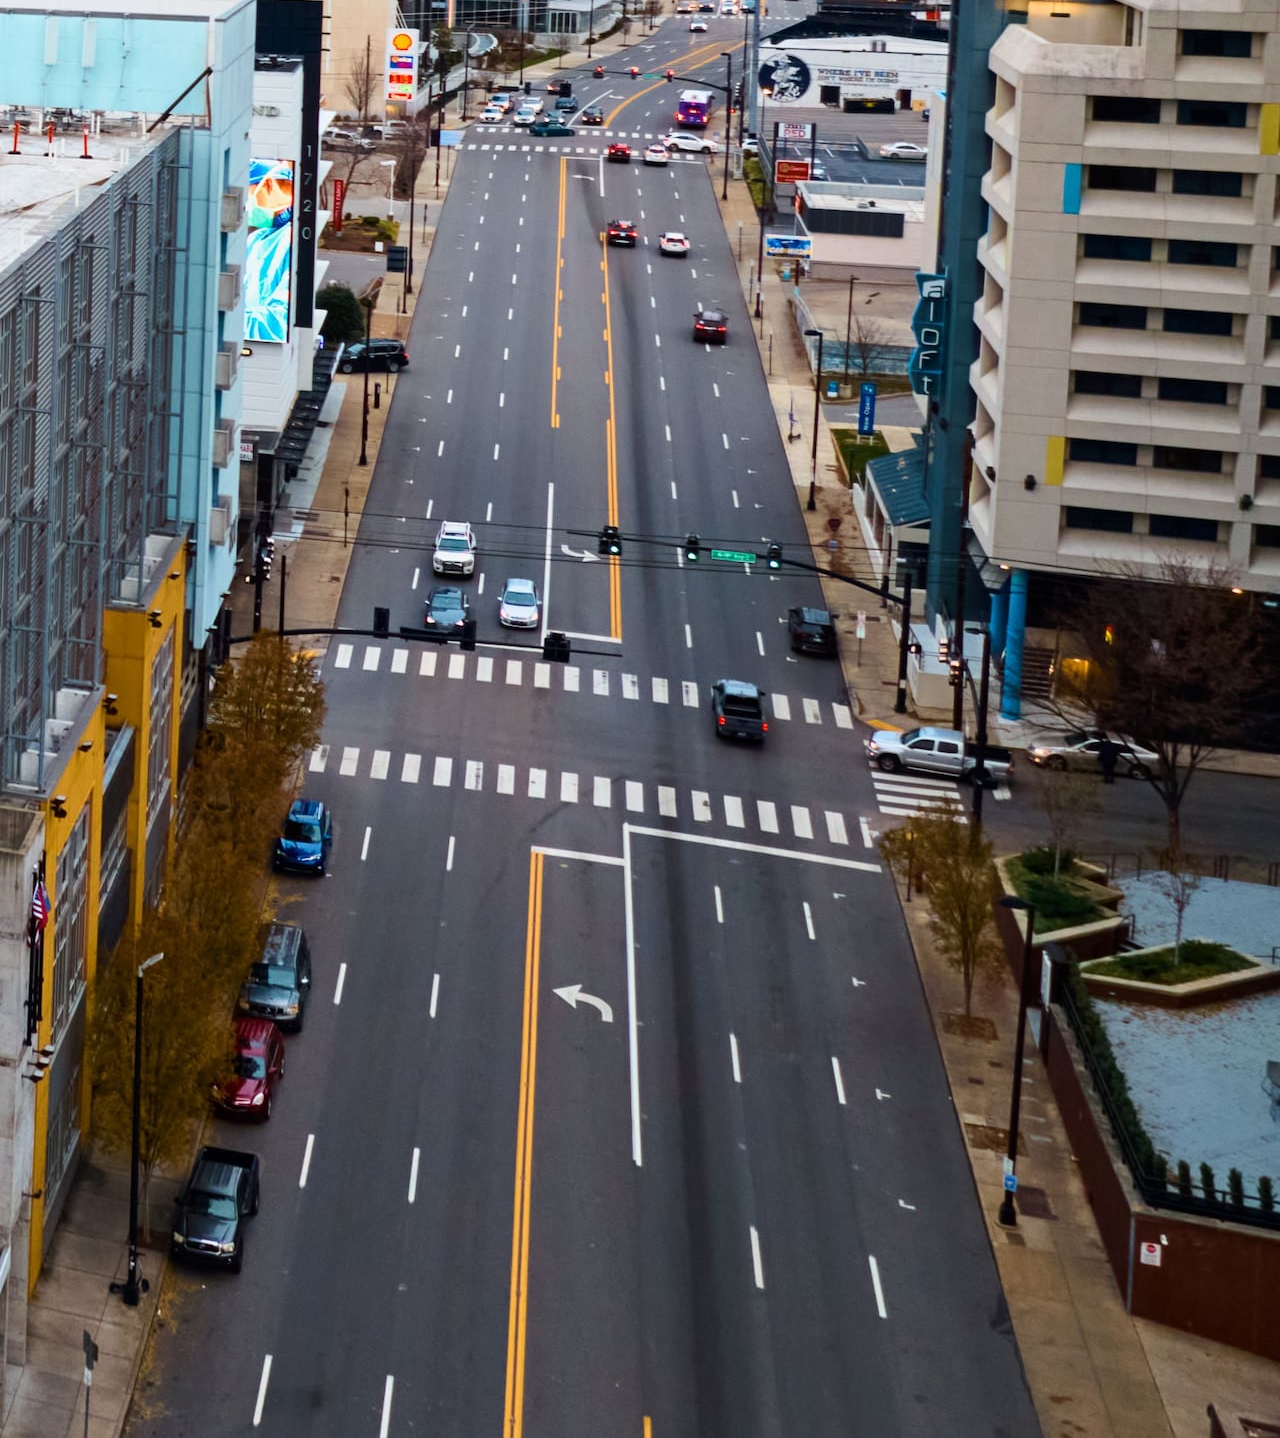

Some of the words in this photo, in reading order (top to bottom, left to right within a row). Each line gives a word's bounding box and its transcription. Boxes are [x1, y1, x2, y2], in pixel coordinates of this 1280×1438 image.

[817, 68, 852, 76] WHERE
[874, 70, 899, 78] BEEN
[301, 144, 313, 240] 1720
[918, 279, 945, 395] aloft
